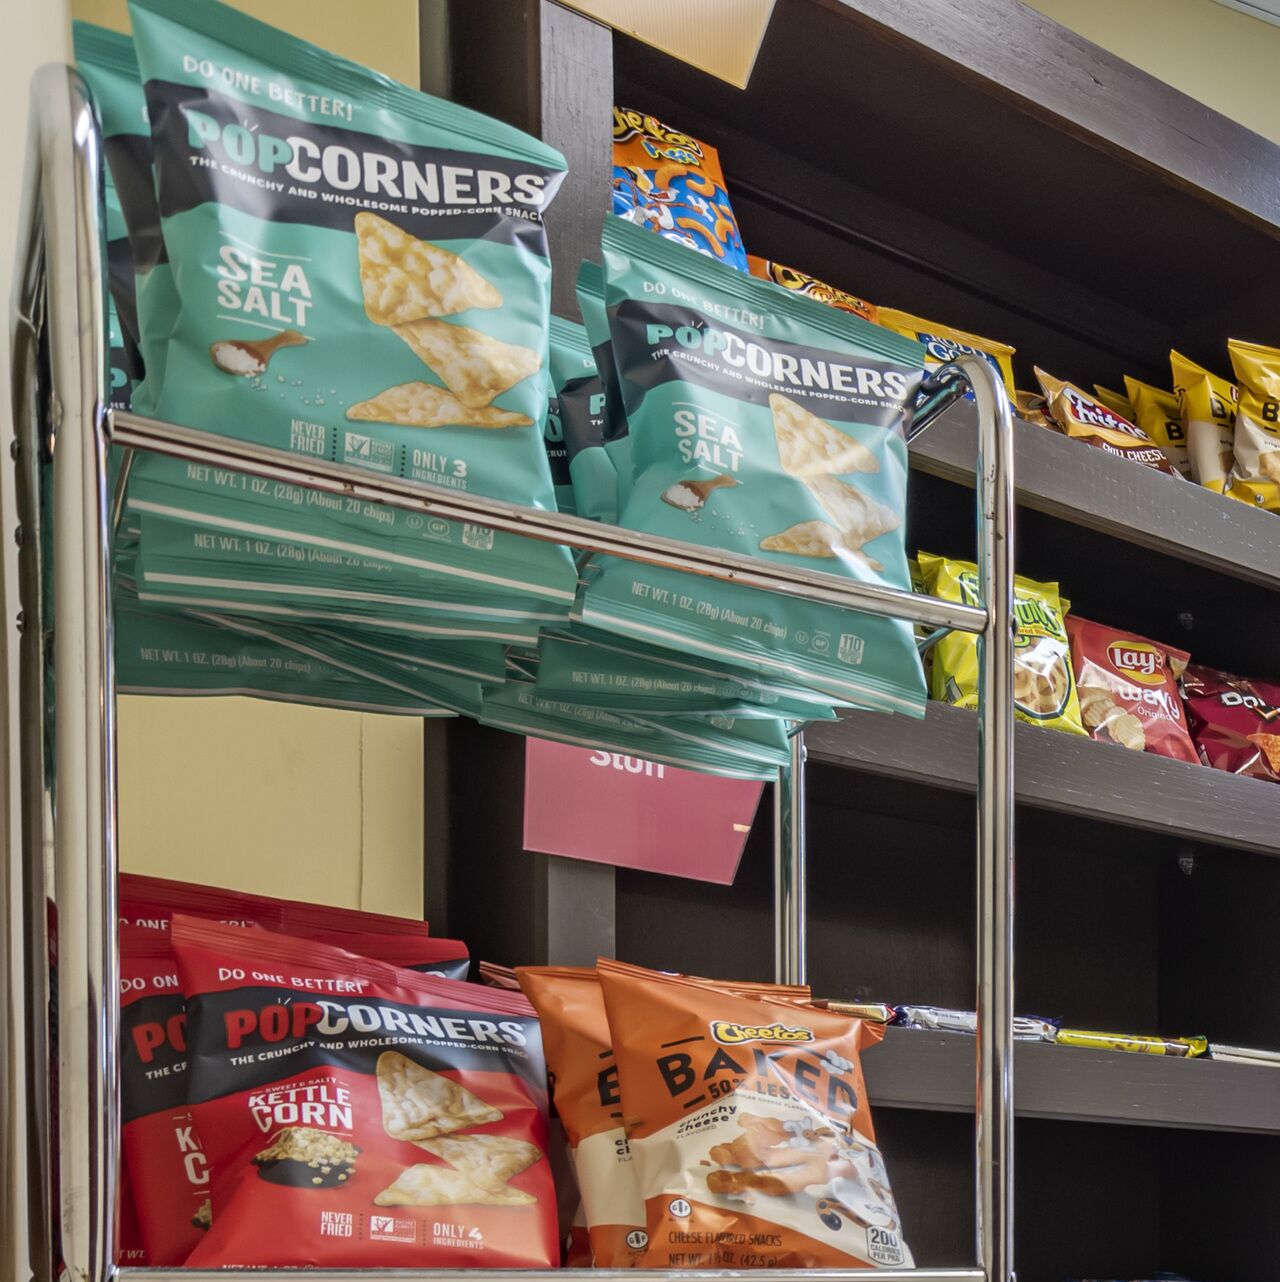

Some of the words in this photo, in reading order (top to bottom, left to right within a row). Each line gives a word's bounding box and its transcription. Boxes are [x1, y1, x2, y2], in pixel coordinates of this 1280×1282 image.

[183, 55, 214, 77] DO
[220, 65, 261, 92] ONE
[267, 79, 354, 121] BETTER!
[186, 109, 547, 207] POPCORNERS
[218, 244, 312, 290] SEA
[217, 279, 313, 326] SALT
[646, 319, 908, 400] POPCORNERS
[290, 418, 325, 439] NEVER
[1063, 387, 1150, 440] Fritos
[290, 434, 325, 456] FRIED
[674, 410, 739, 451] SEA
[412, 448, 448, 474] ONLY
[453, 459, 467, 477] 3
[681, 439, 744, 473] SALT
[186, 465, 211, 482] NET
[214, 469, 237, 489] WT.
[241, 475, 247, 490] 1
[251, 478, 272, 496] OZ.
[274, 482, 304, 505] (28g)
[307, 489, 344, 512] (About
[346, 497, 361, 515] 20
[363, 501, 395, 527] chips)
[219, 968, 245, 981] DO
[252, 972, 284, 985] ONE
[291, 977, 363, 994] BETTER!
[225, 1000, 528, 1049] POPCORNERS
[713, 1021, 814, 1044] Cheetos
[230, 1055, 254, 1066] THE
[258, 1041, 316, 1063] CRUNCHY
[319, 1041, 344, 1050] AND
[348, 1034, 423, 1049] WHOLESOME
[426, 1038, 499, 1052] POPPED-CORN
[248, 1083, 351, 1108] KETTLE
[656, 1047, 858, 1118] BAKED
[251, 1101, 353, 1134] CORN
[320, 1221, 352, 1237] FRIED
[321, 1211, 353, 1225] NEVER
[433, 1222, 465, 1238] ONLY
[468, 1226, 483, 1240] 4
[433, 1237, 483, 1249] INGREDIENTS
